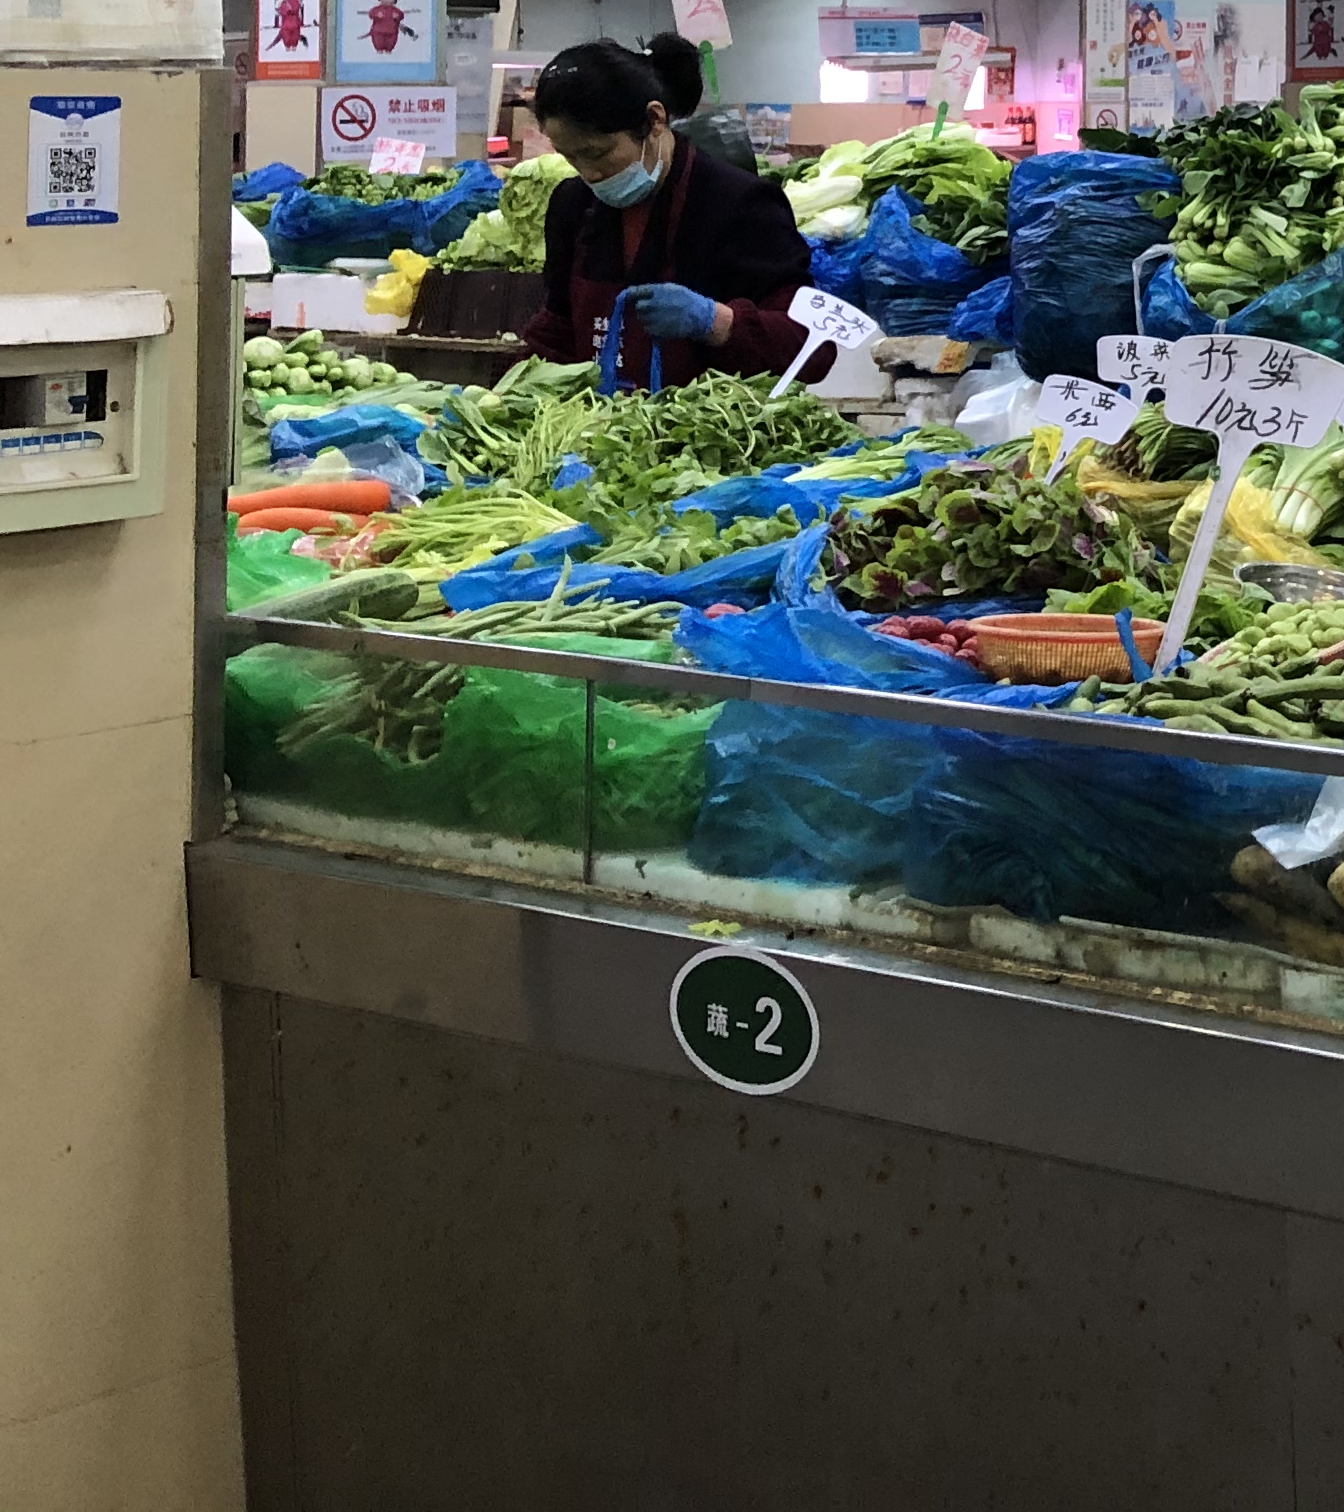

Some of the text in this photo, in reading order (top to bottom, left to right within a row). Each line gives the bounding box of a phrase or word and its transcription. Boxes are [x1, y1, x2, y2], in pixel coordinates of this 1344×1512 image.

[388, 98, 446, 114] 禁止吸烟
[1121, 364, 1165, 388] 5元
[706, 996, 783, 1056] 蔬-2
